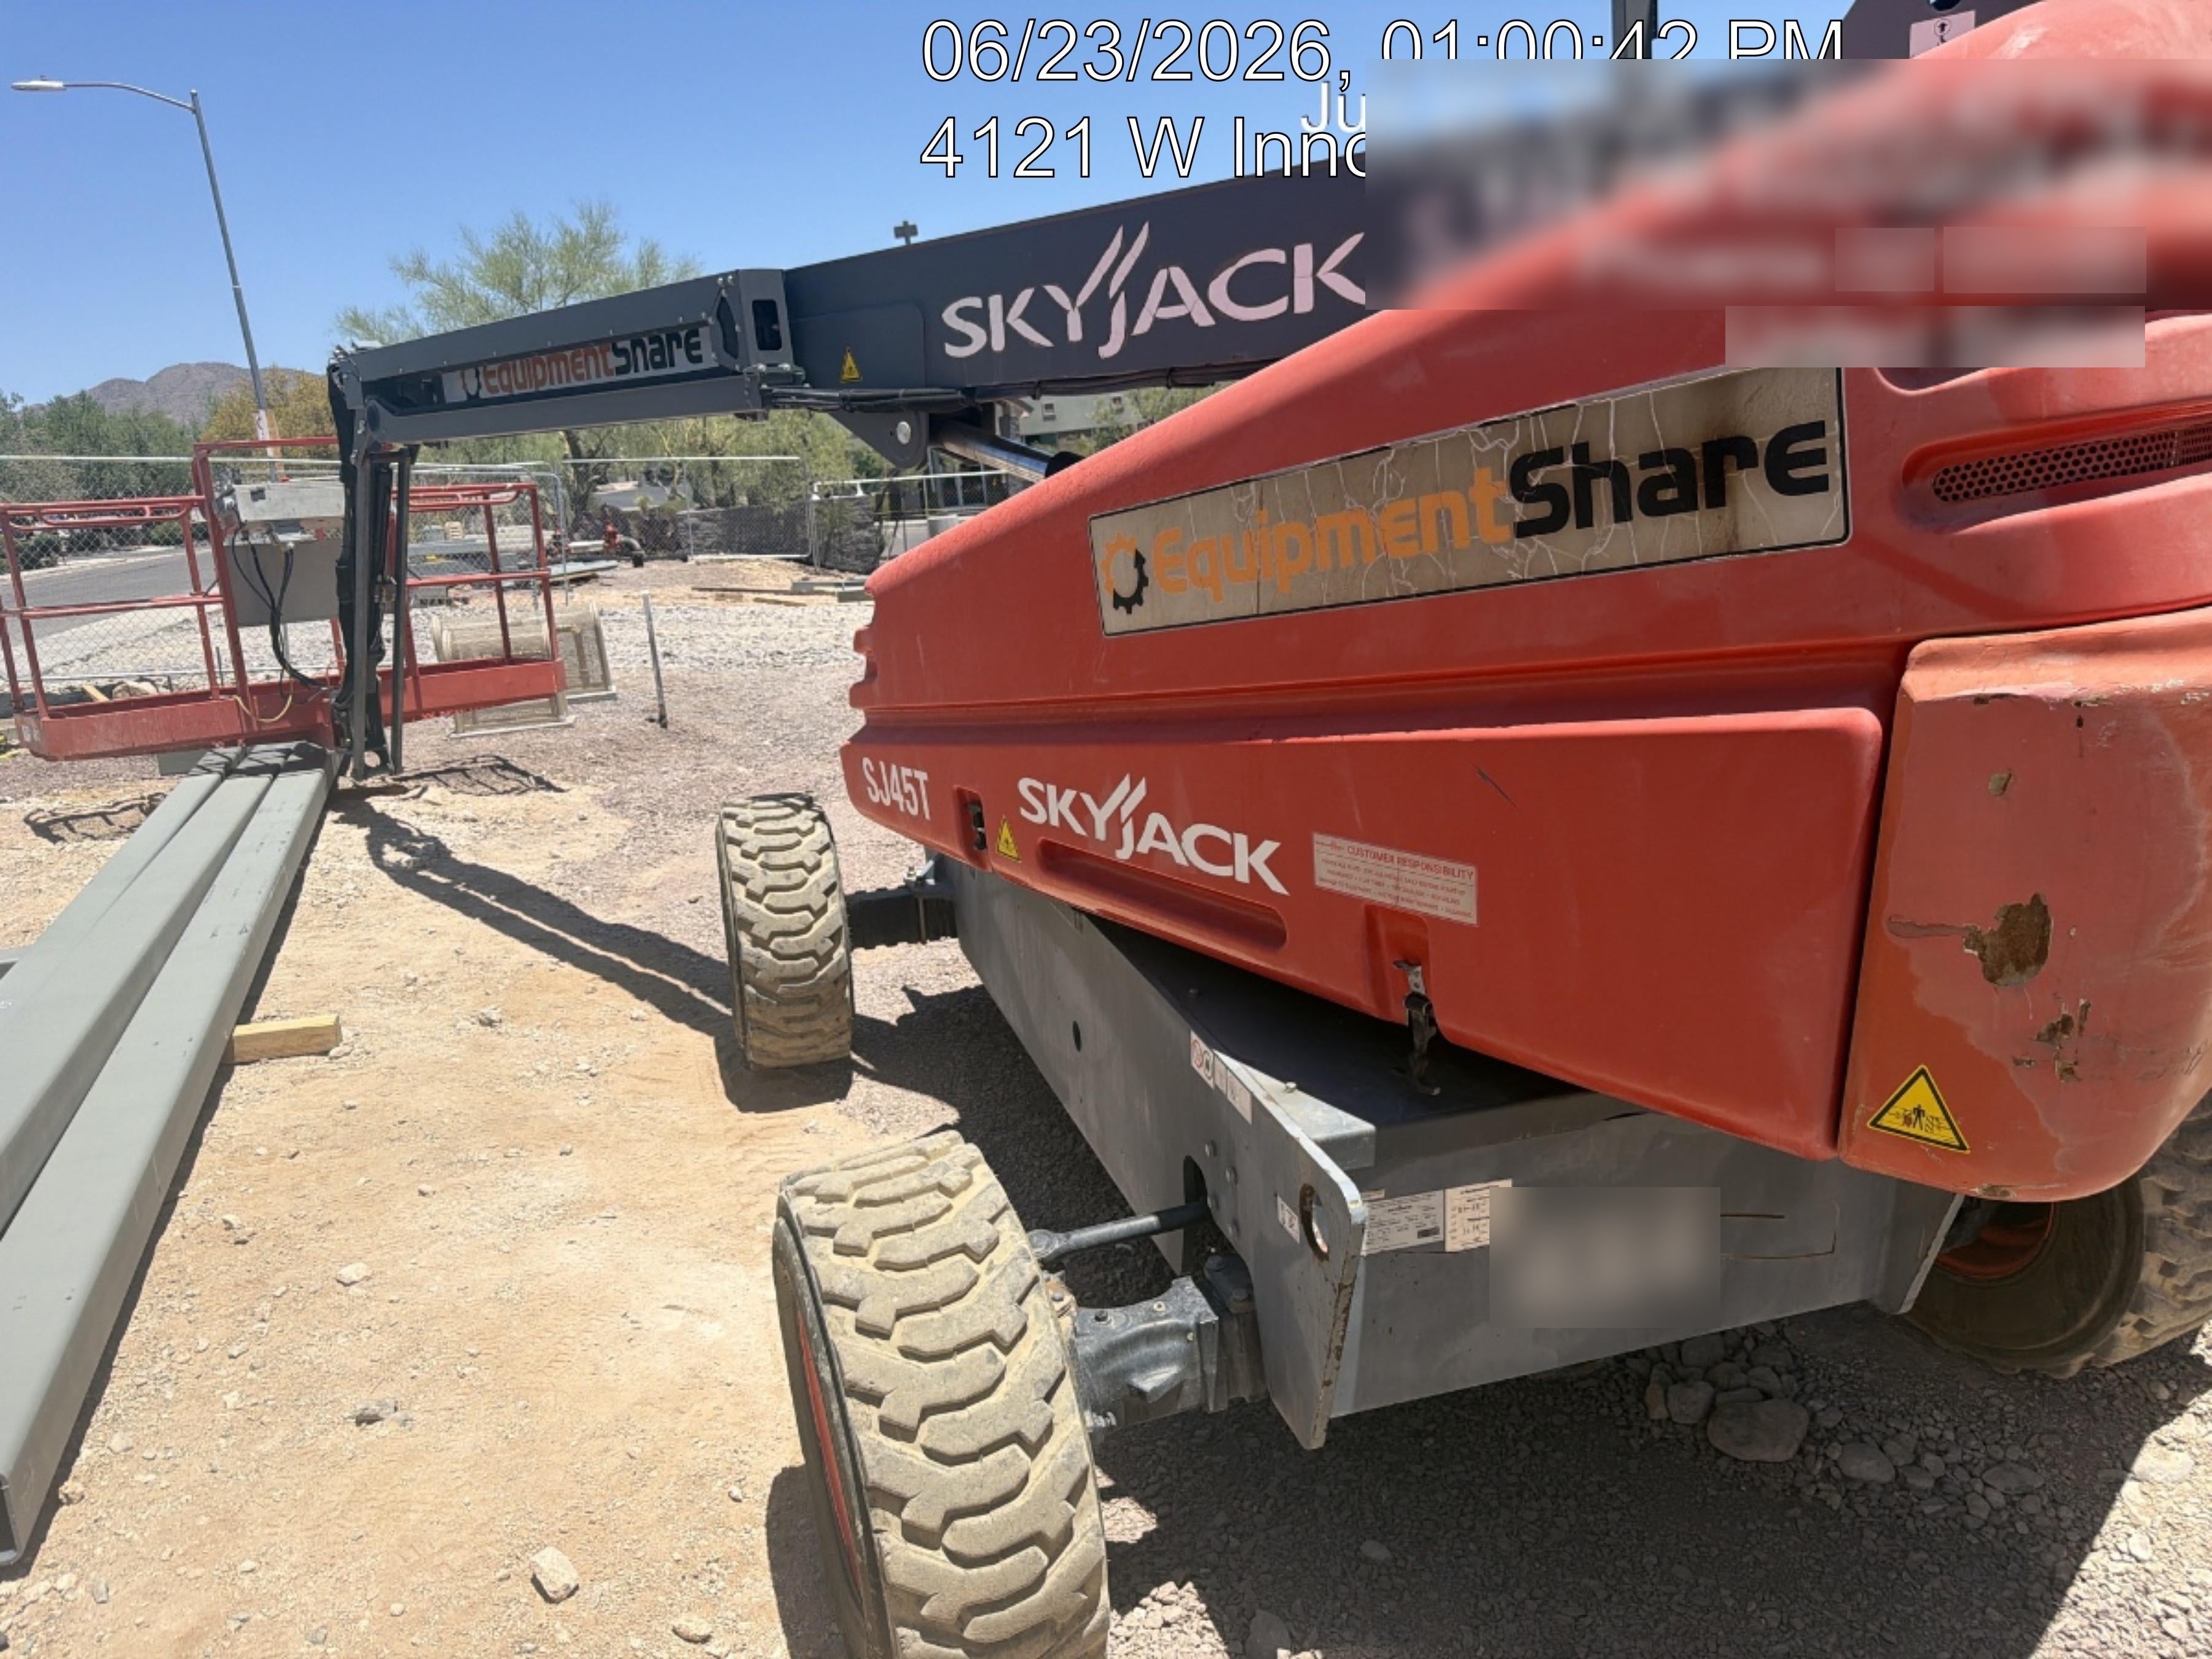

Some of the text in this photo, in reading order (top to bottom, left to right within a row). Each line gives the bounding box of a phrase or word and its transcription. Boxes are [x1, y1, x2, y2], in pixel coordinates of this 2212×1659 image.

[940, 221, 1366, 359] SKYJACK
[482, 328, 704, 396] EquipmentShare
[1153, 420, 1831, 603] EquipmentShare
[861, 756, 931, 820] SJ45T
[1017, 772, 1290, 896] SKYJACK
[1347, 845, 1394, 865] CUSTOMER
